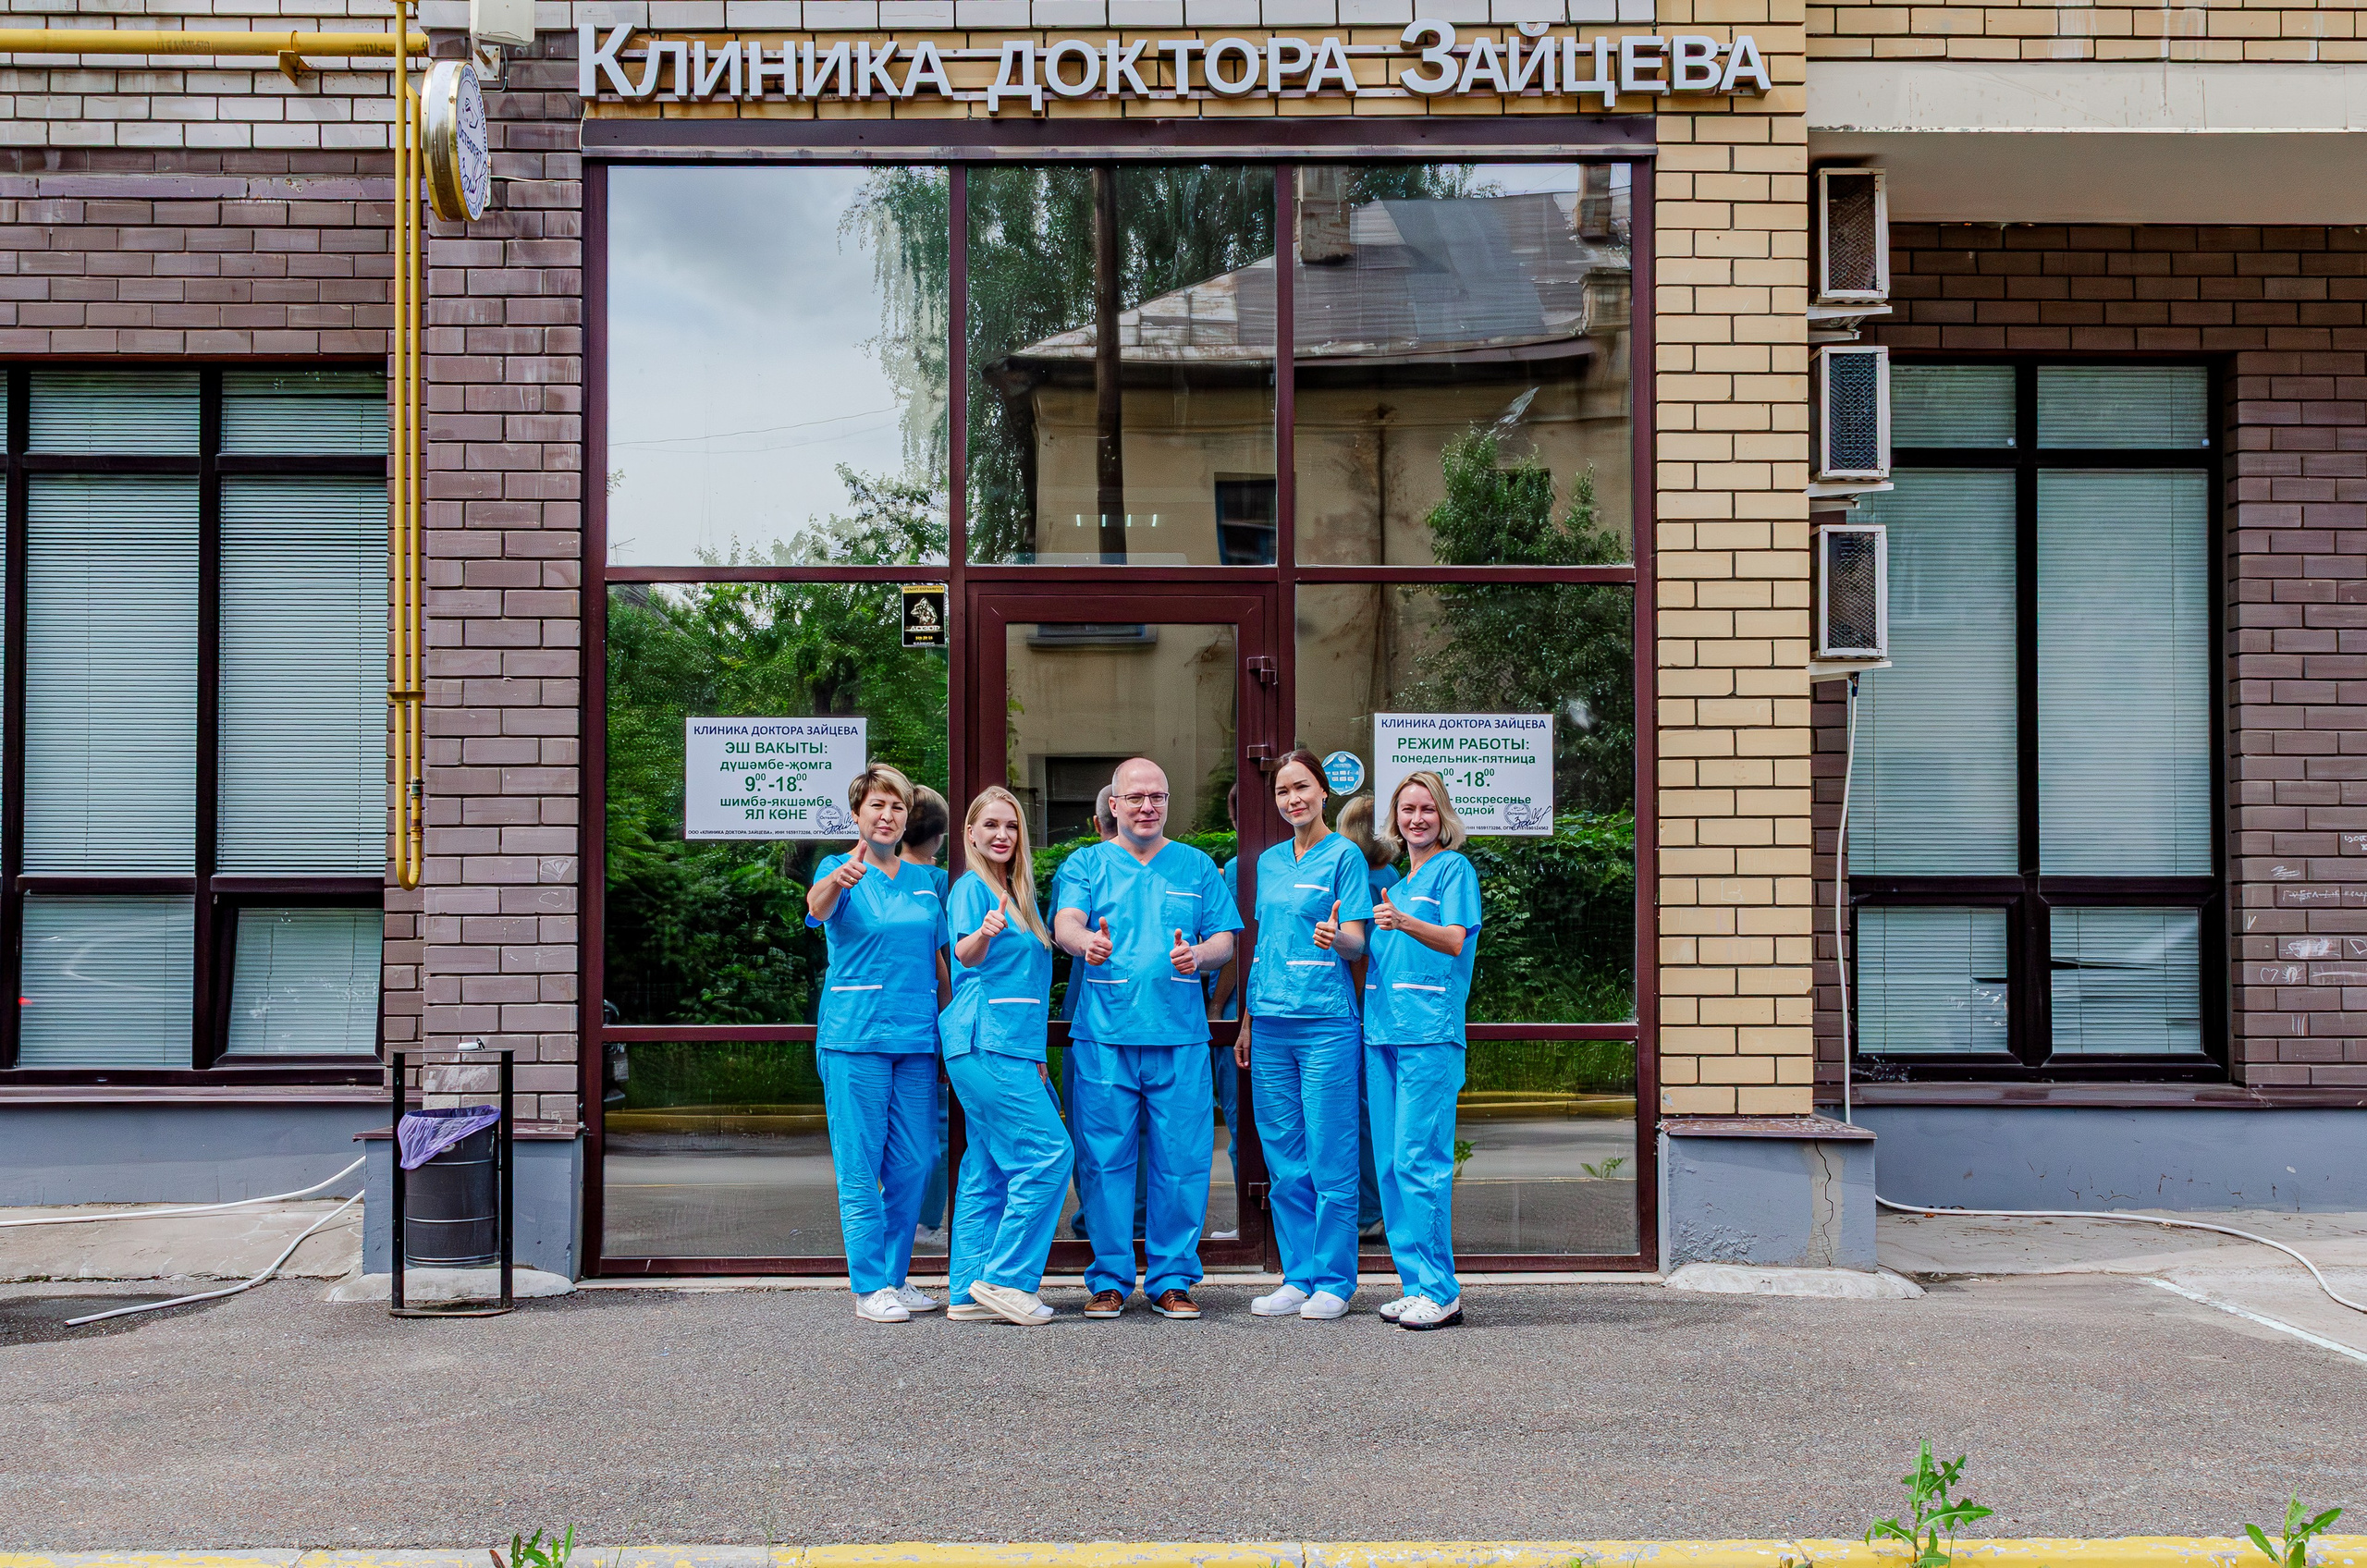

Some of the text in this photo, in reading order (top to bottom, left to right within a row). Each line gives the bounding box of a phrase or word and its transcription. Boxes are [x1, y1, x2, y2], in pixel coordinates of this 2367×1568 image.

[578, 18, 1772, 116] КЛИНИКА ДОКТОРА ЗАЙЦЕВА
[1381, 717, 1546, 729] КЛИНИКА ДОКТОРА ЗАЙЦЕВА
[693, 723, 858, 737] КЛИНИКА ДОКТОРА ЗАЙЦЕВА
[725, 741, 828, 753] ЭШ ВАКЫТЫ:
[1398, 738, 1530, 750] РЕЖИМ РАБОТЫ:
[720, 759, 832, 773] дүшәмбе-җомга
[1392, 754, 1536, 766] понедельник-пятница
[720, 796, 833, 807] шимбә-якшәмбе
[745, 809, 807, 820] ЯЛ КӨНЕ
[1454, 805, 1495, 816] одной
